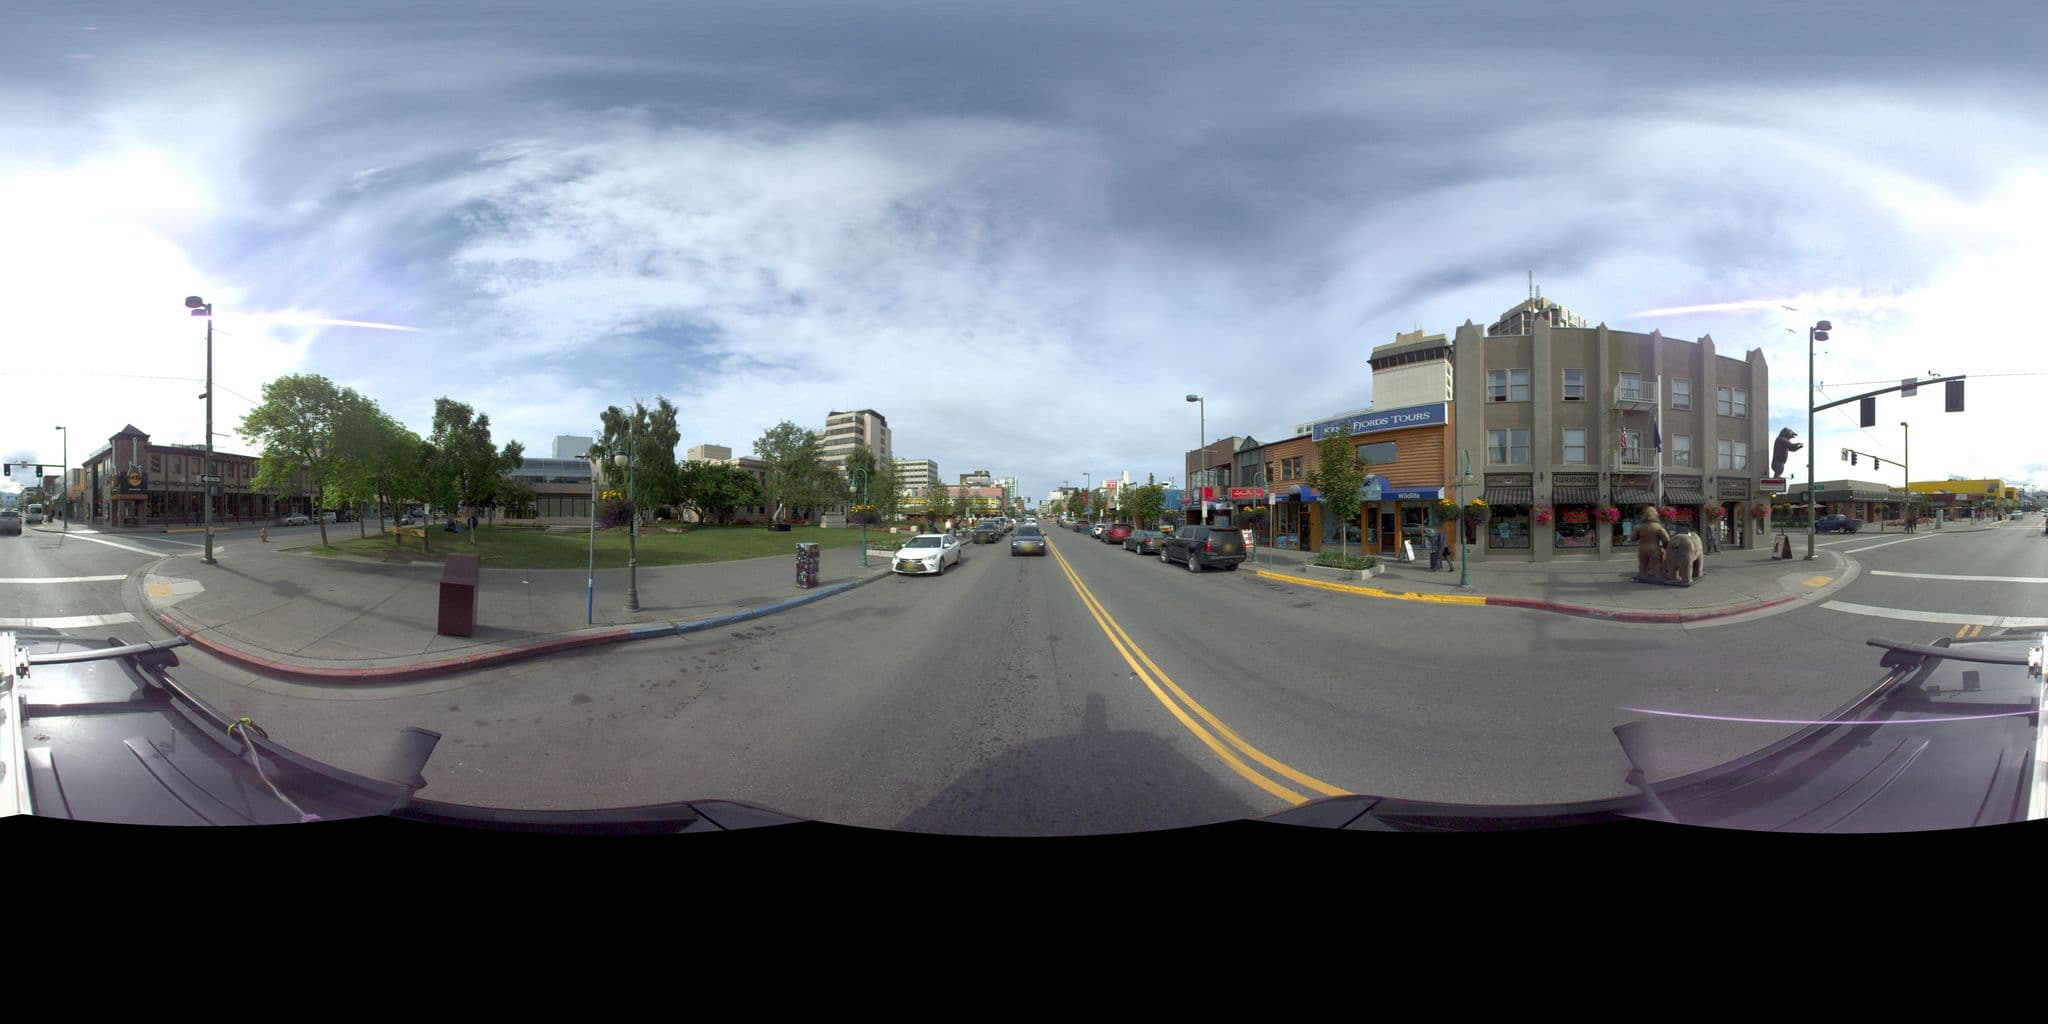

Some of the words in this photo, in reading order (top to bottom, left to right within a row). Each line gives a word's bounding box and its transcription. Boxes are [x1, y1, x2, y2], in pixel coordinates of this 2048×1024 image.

[1353, 417, 1389, 430] FJORDS
[1390, 411, 1431, 424] TOURS
[1555, 475, 1597, 484] CURIOSITIES
